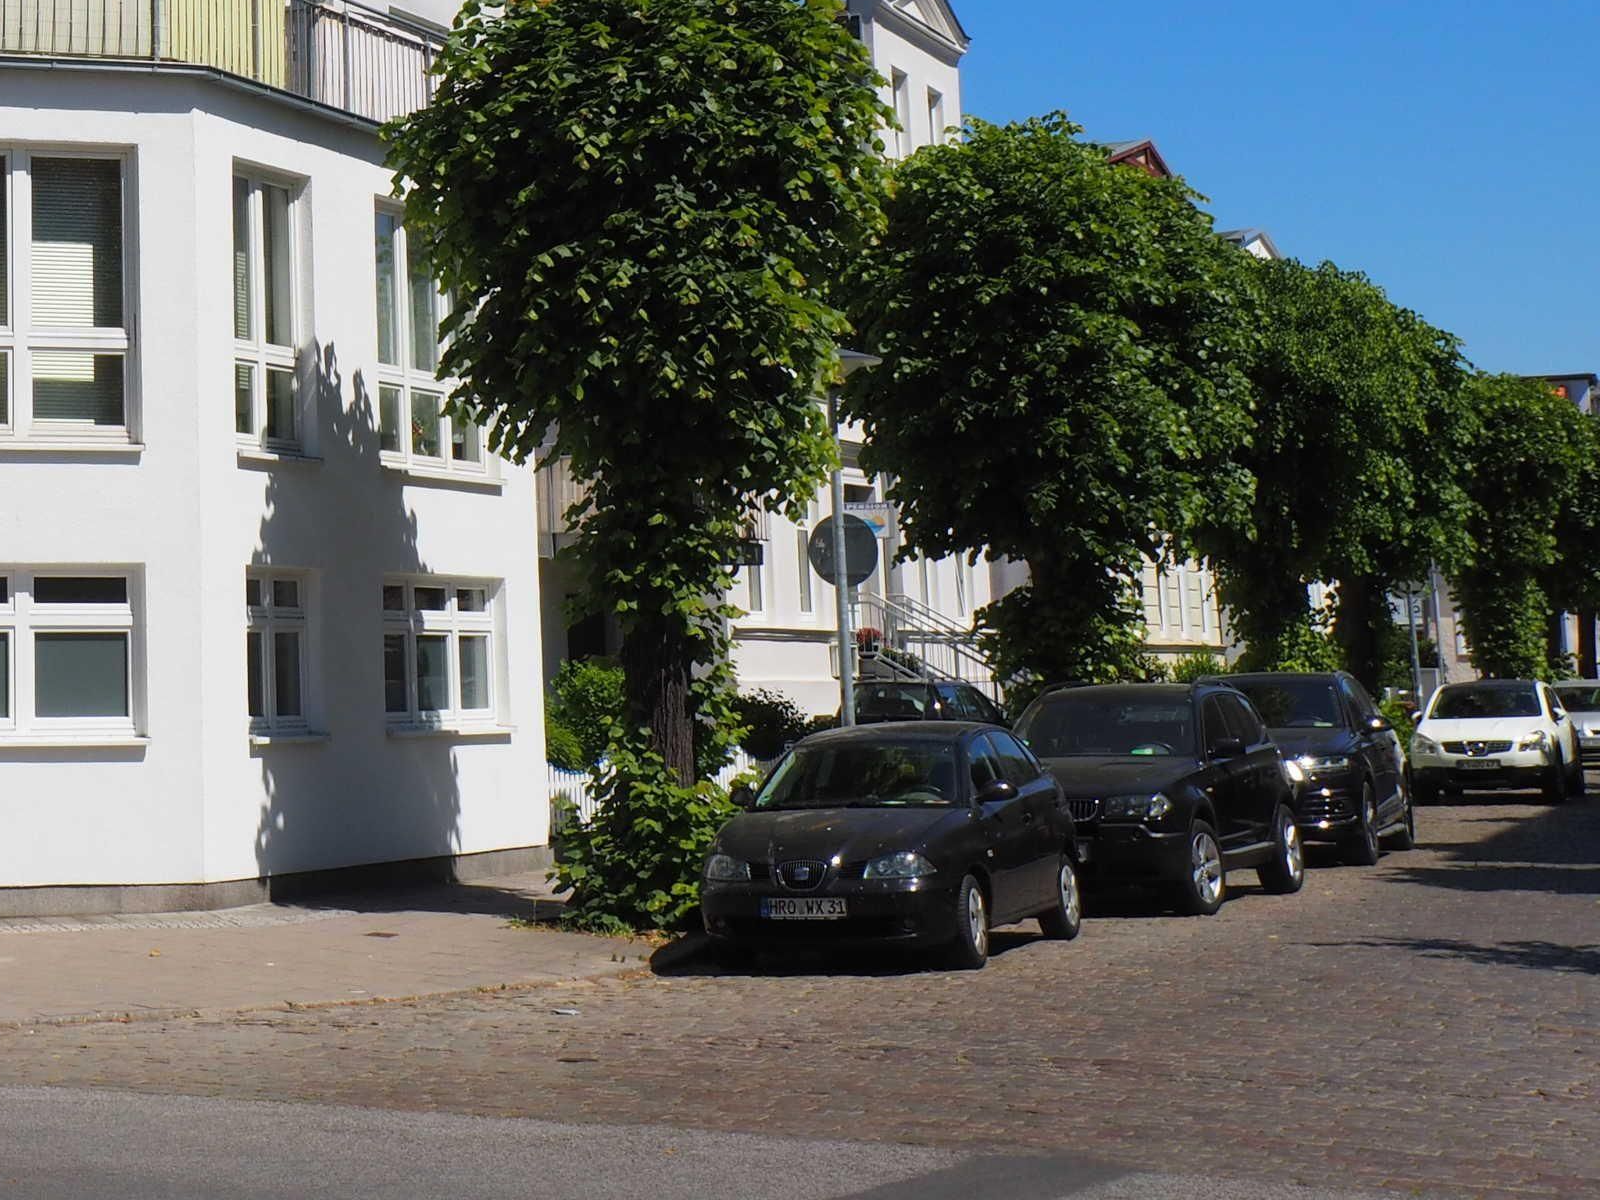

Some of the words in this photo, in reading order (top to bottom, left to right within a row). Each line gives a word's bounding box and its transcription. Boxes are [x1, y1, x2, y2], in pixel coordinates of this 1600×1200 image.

[768, 900, 797, 915] HRO
[806, 899, 825, 915] WX
[828, 899, 845, 914] 31
